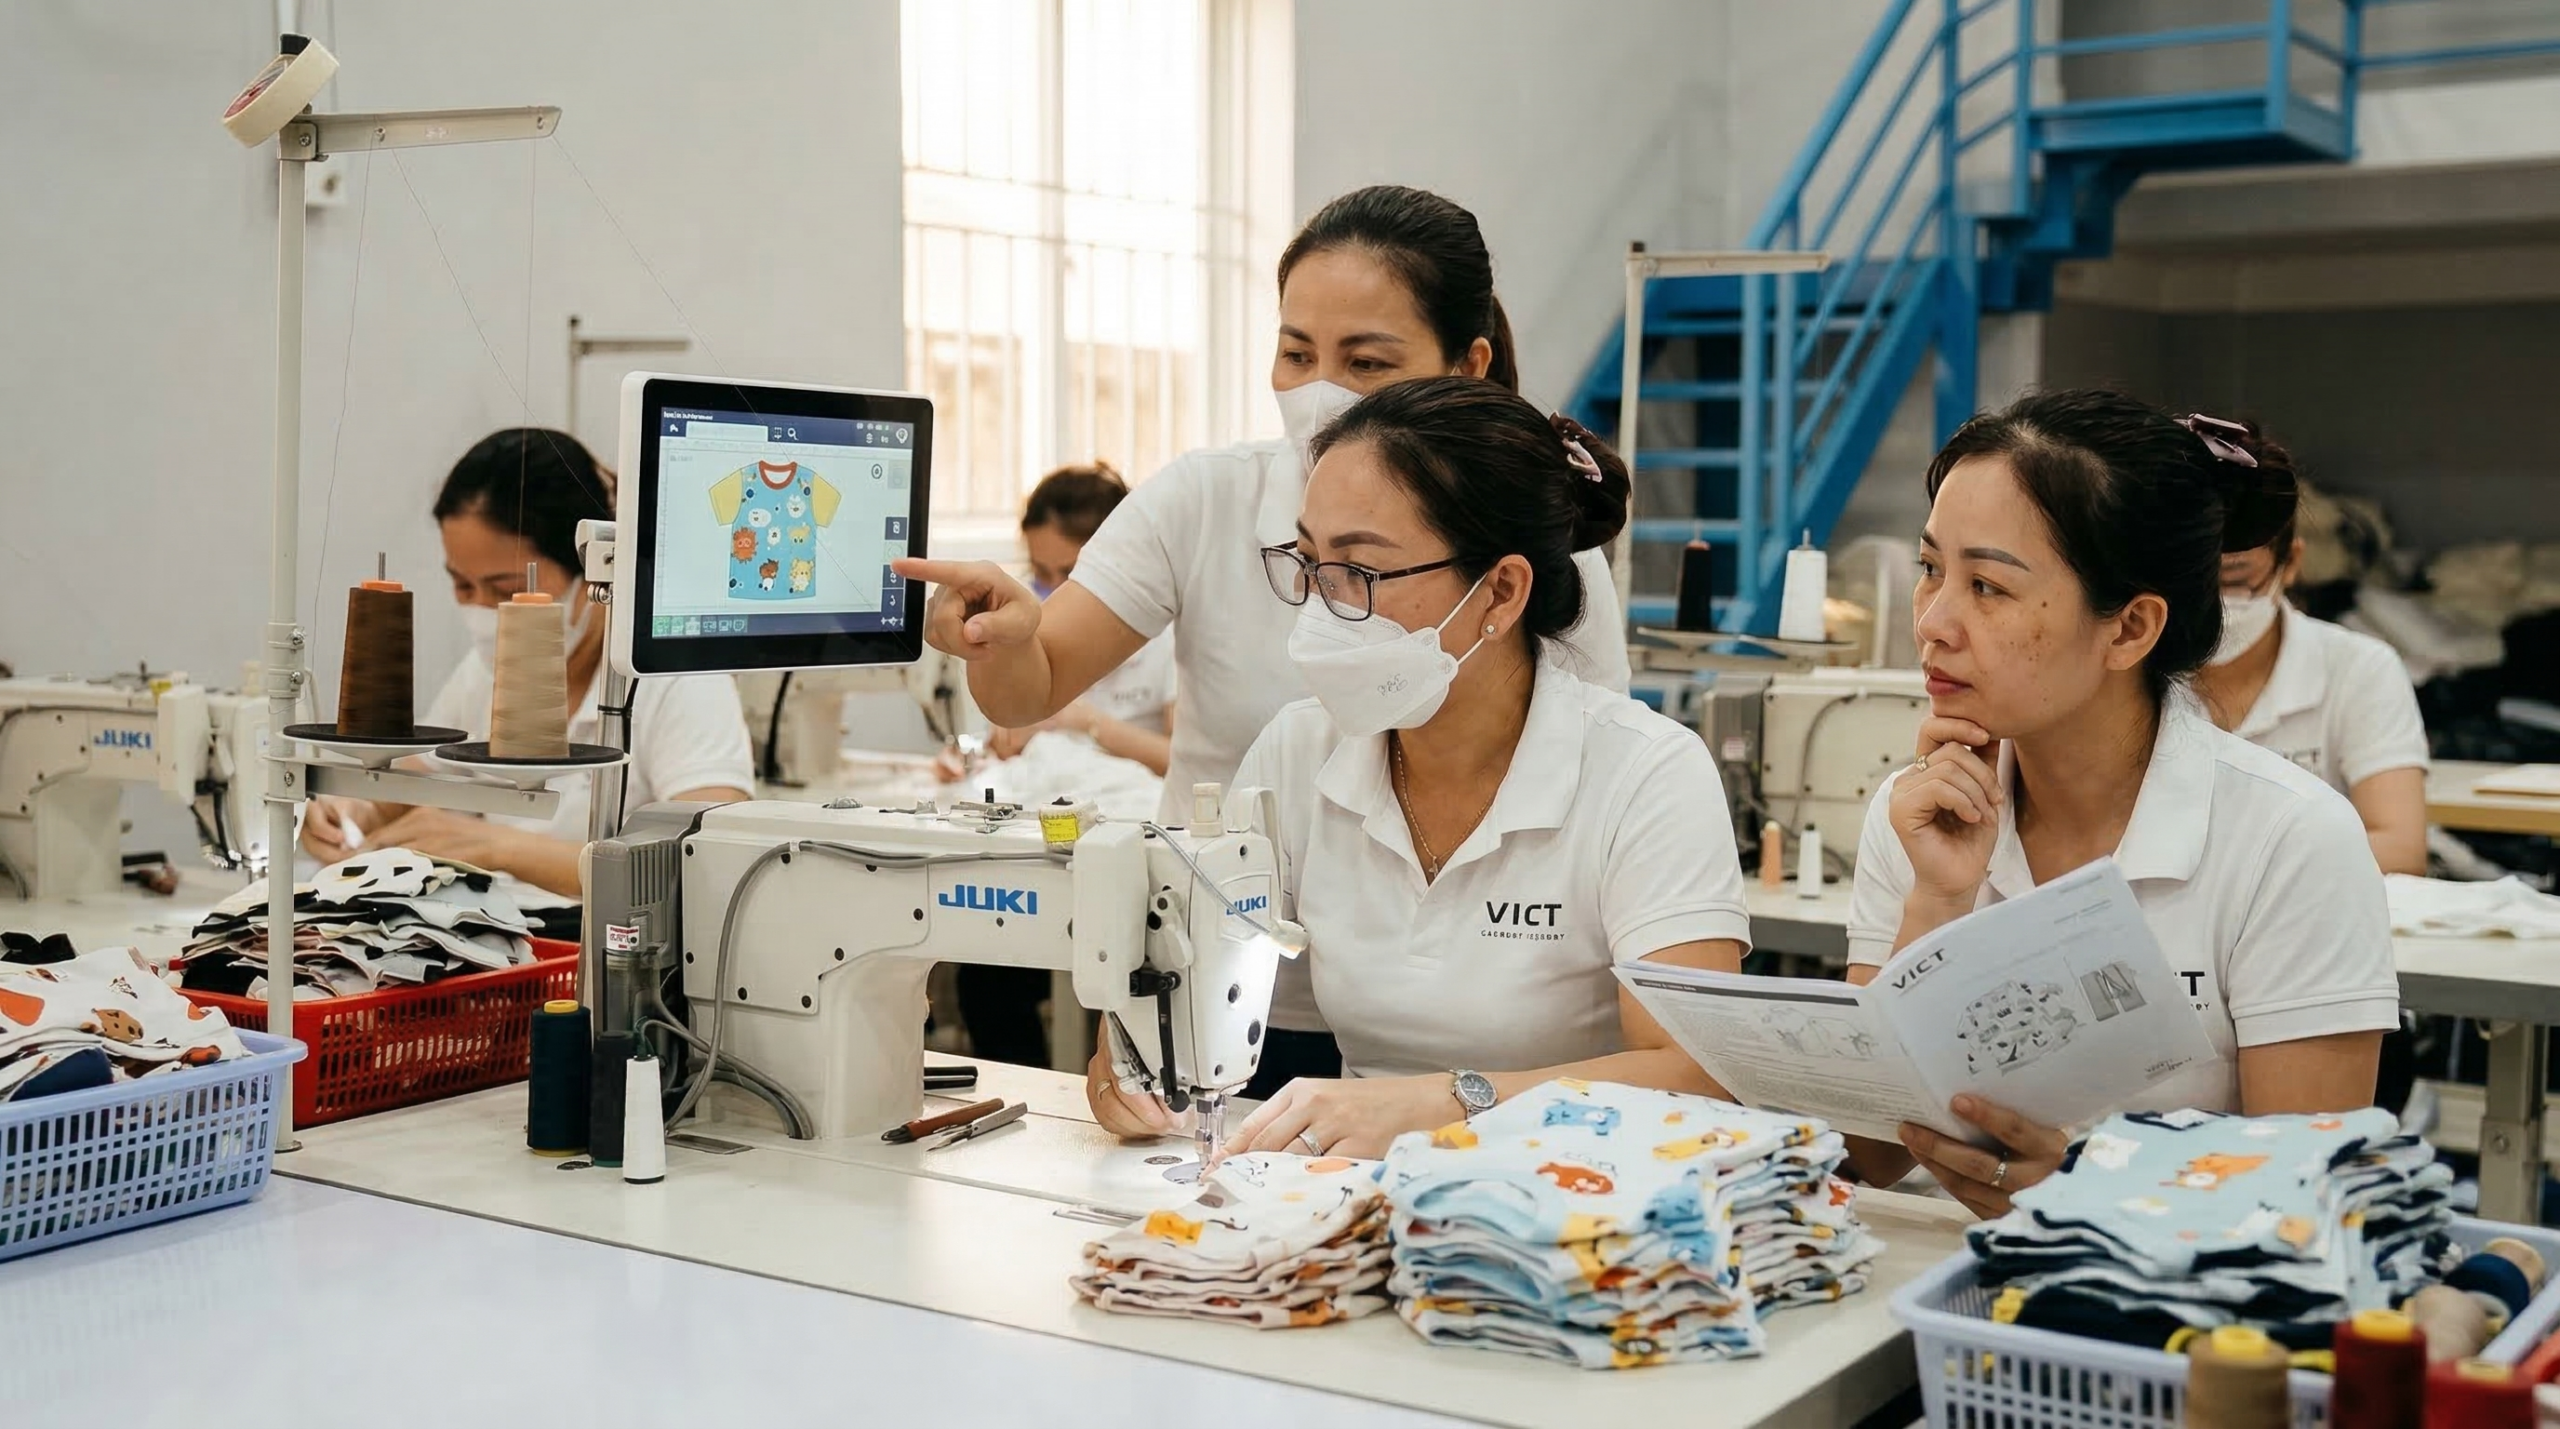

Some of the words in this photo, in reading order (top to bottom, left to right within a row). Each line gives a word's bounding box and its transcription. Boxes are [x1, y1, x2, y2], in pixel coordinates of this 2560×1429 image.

[93, 729, 151, 750] JUKI
[938, 884, 1038, 915] JUKI
[1486, 901, 1562, 926] VICT
[1891, 948, 1945, 989] VICT
